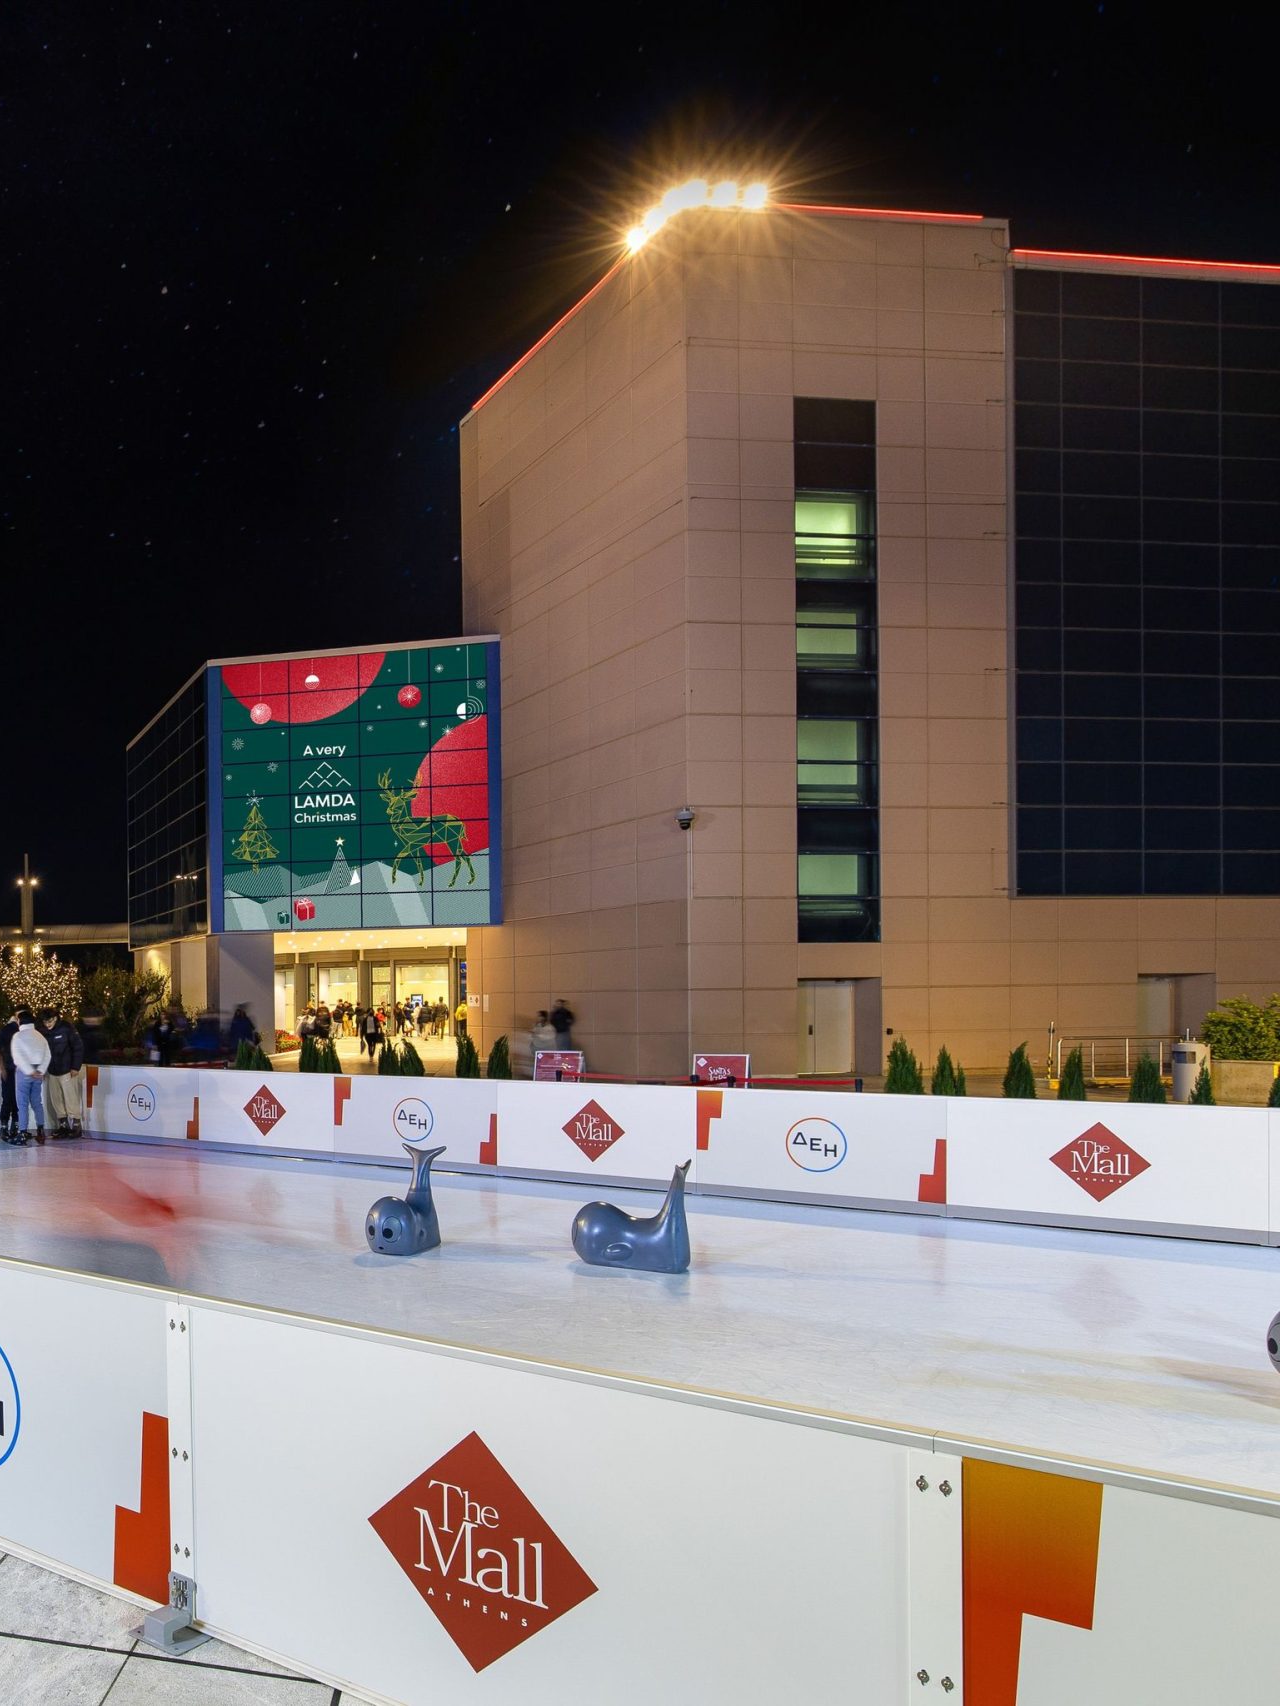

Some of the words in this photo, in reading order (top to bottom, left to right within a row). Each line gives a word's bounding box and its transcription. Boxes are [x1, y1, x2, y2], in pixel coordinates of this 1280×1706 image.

[303, 745, 313, 756] A
[315, 745, 346, 757] very
[294, 793, 356, 809] LAMDA
[294, 812, 357, 823] Christmas
[130, 1093, 151, 1111] ΔΕΗ
[252, 1103, 278, 1119] Mall
[397, 1109, 427, 1130] ΔΕΗ
[579, 1113, 600, 1128] The
[575, 1121, 613, 1141] Mall
[792, 1131, 837, 1158] ΔΕΗ
[1077, 1140, 1111, 1158] The
[1070, 1150, 1131, 1176] Mall
[428, 1479, 499, 1533] The
[413, 1506, 549, 1610] Mall
[427, 1587, 528, 1627] ATHENS
